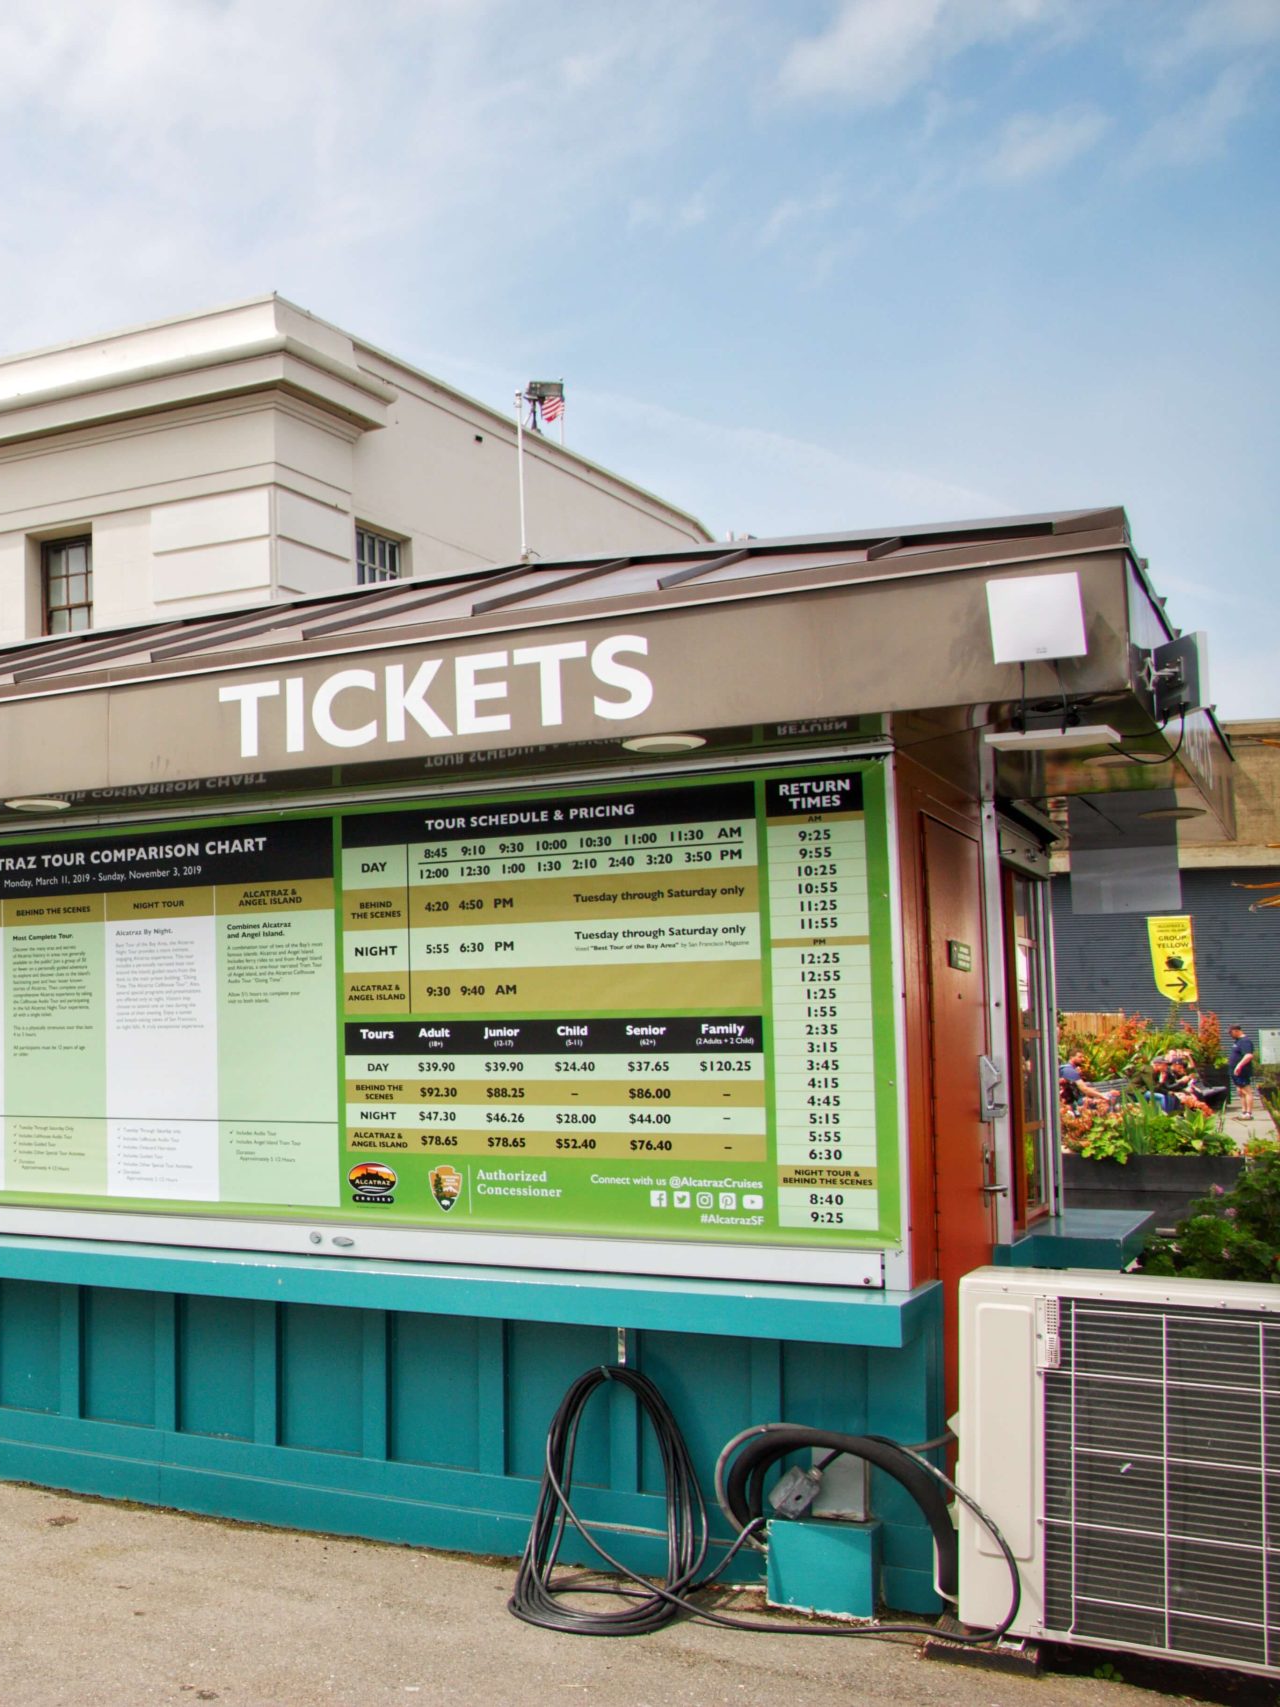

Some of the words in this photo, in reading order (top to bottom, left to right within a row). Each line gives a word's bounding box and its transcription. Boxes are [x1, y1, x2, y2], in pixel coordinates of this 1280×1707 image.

[219, 634, 654, 757] TICKETS
[779, 779, 850, 795] RETURN
[789, 795, 840, 809] TIMES
[425, 818, 466, 831] TOUR
[470, 811, 549, 827] SCHEDULE
[553, 809, 563, 821] &
[569, 803, 635, 820] PRICING
[799, 829, 830, 841] 9:25
[424, 847, 448, 859] 8:45
[461, 845, 485, 856] 9:10
[499, 842, 524, 854] 9:30
[536, 839, 567, 851] 10:00
[579, 835, 611, 848] 10:30
[624, 832, 657, 845] 11:00
[670, 829, 704, 842] 11:30
[718, 826, 742, 838] AM
[41, 852, 85, 867] TOUR
[90, 843, 199, 864] COMPARISON
[205, 837, 266, 855] CHART
[799, 847, 831, 859] 9:55
[361, 861, 387, 874] DAY
[419, 867, 449, 880] 12:00
[460, 865, 490, 877] 12:30
[502, 862, 525, 875] 1:00
[537, 860, 561, 872] 1:30
[572, 858, 597, 870] 2:10
[609, 856, 634, 868] 2:40
[646, 853, 672, 865] 3:20
[685, 851, 712, 863] 3:50
[720, 848, 742, 860] PM
[798, 864, 836, 876] 10:25
[4, 879, 33, 888] Monday,
[36, 876, 58, 885] March
[73, 874, 90, 883] 2019
[98, 872, 126, 882] Sunday,
[129, 868, 170, 880] November
[173, 867, 180, 876] 3,
[183, 866, 202, 875] 2019
[243, 889, 288, 898] ALCATRAZ
[162, 900, 184, 908] TOUR
[239, 898, 267, 906] ANGEL
[270, 895, 302, 905] ISLAND
[360, 901, 392, 909] BEHIND
[425, 900, 449, 912] 4:20
[459, 899, 483, 911] 4:50
[494, 897, 513, 909] PM
[63, 906, 90, 914] SCENES
[351, 911, 368, 919] THE
[370, 910, 402, 918] SCENES
[801, 917, 837, 929] 11:55
[574, 931, 618, 940] Tuesday
[622, 928, 665, 939] through
[669, 926, 718, 936] Saturday
[722, 925, 746, 935] only
[355, 945, 397, 957] NIGHT
[426, 943, 449, 954] 5:55
[460, 941, 484, 953] 6:30
[494, 940, 514, 952] PM
[801, 953, 839, 964] 12:25
[426, 986, 450, 997] 9:30
[460, 985, 485, 996] 9:40
[495, 984, 517, 996] AM
[348, 994, 374, 1002] ANGEL
[376, 993, 405, 1001] ISLAND
[360, 1029, 394, 1039] Tours
[419, 1028, 450, 1037] Adult
[484, 1027, 519, 1039] Junior
[557, 1026, 588, 1036] Child
[626, 1025, 666, 1035] Senior
[701, 1024, 744, 1036] Family
[368, 1063, 389, 1072] DAY
[418, 1062, 455, 1072] $39.90
[485, 1062, 523, 1072] $39.90
[555, 1062, 595, 1072] $24.40
[628, 1061, 669, 1072] $37.65
[700, 1061, 751, 1072] $120.25
[420, 1087, 457, 1097] $92.30
[487, 1088, 524, 1098] $88.25
[629, 1088, 671, 1099] $86.00
[361, 1112, 396, 1120] NIGHT
[419, 1112, 456, 1121] $47.30
[486, 1113, 524, 1123] $46.26
[556, 1114, 596, 1124] $28.00
[629, 1114, 671, 1124] $44.00
[421, 1136, 457, 1146] $78.65
[488, 1137, 525, 1147] $78.65
[556, 1139, 596, 1149] $52.40
[630, 1140, 672, 1150] $76.40
[808, 1149, 842, 1160] 6:30
[477, 1169, 547, 1182] Authorized
[590, 1174, 630, 1184] Connect
[633, 1176, 653, 1185] with
[669, 1176, 763, 1188] @AlcatrazCruises
[477, 1184, 562, 1197] Concessioner
[809, 1194, 843, 1205] 8:40
[701, 1214, 764, 1225] #AlcatrazSF
[811, 1212, 844, 1223] 9:25
